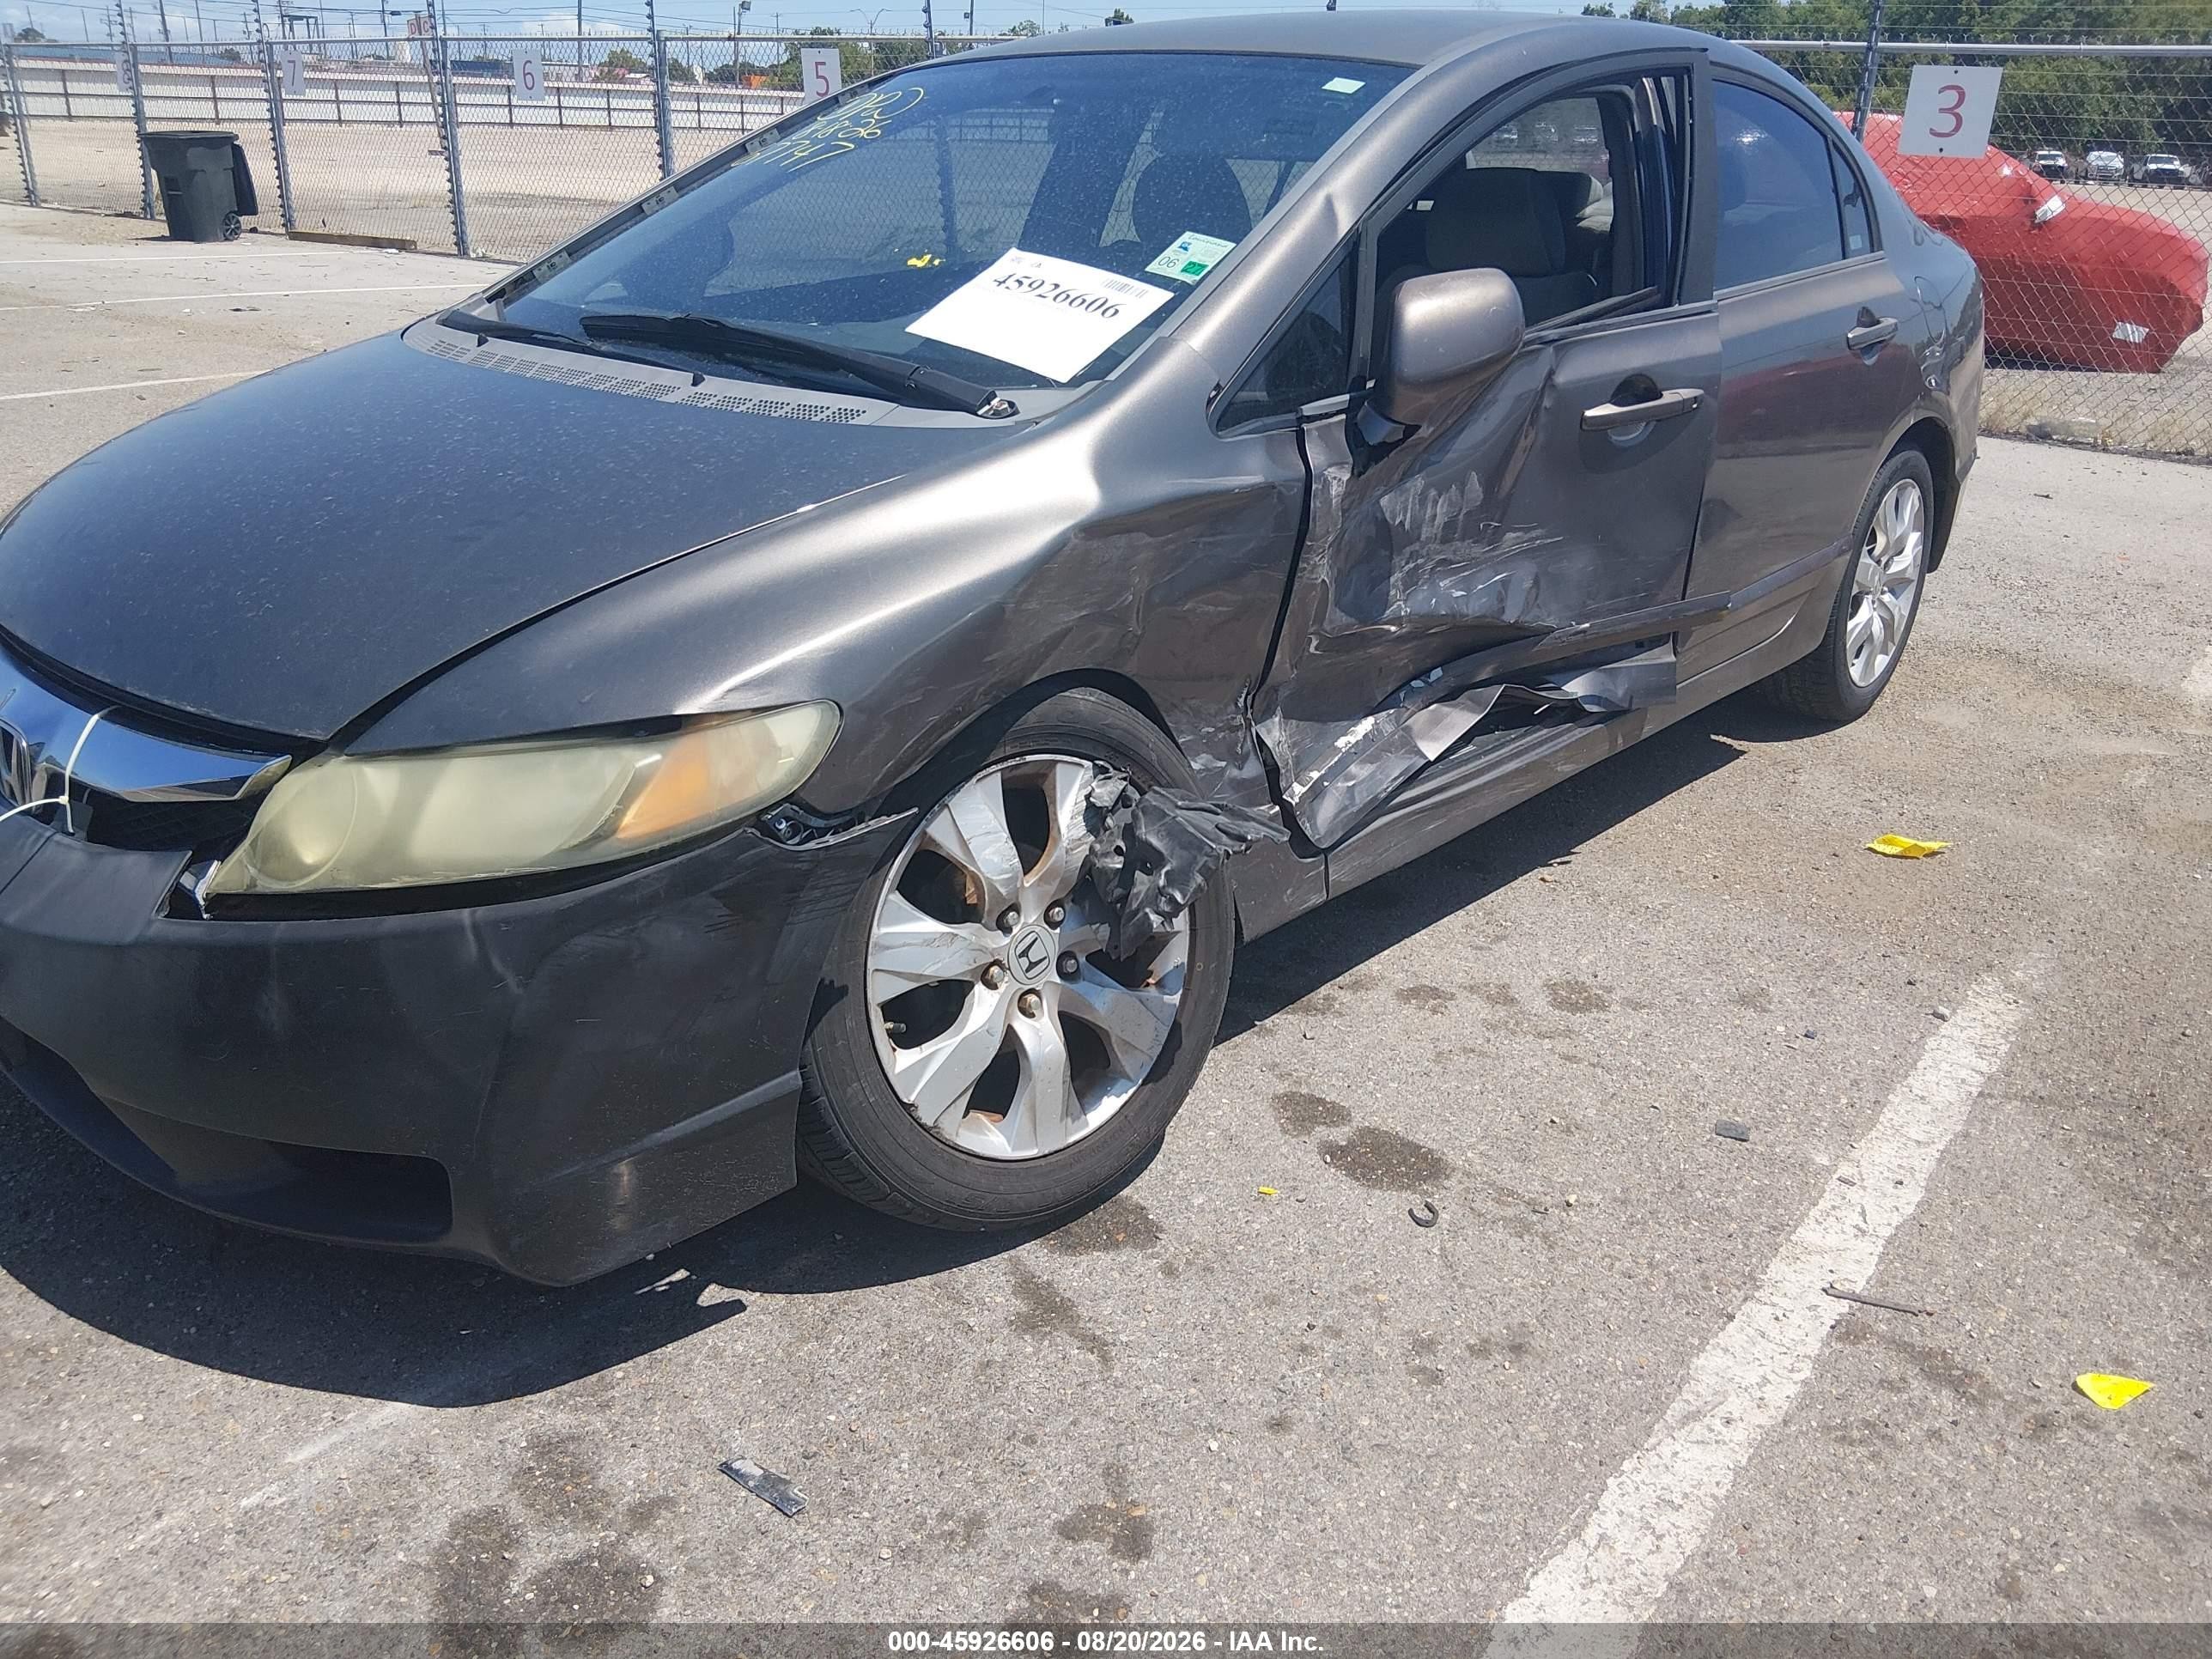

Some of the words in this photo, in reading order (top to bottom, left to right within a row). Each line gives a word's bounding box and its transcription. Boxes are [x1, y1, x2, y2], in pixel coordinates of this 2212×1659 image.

[288, 59, 296, 87] 7
[522, 59, 535, 91] 6
[814, 61, 830, 98] 5
[1929, 84, 1966, 138] 3
[1158, 256, 1181, 269] 06
[993, 272, 1127, 319] 45926606
